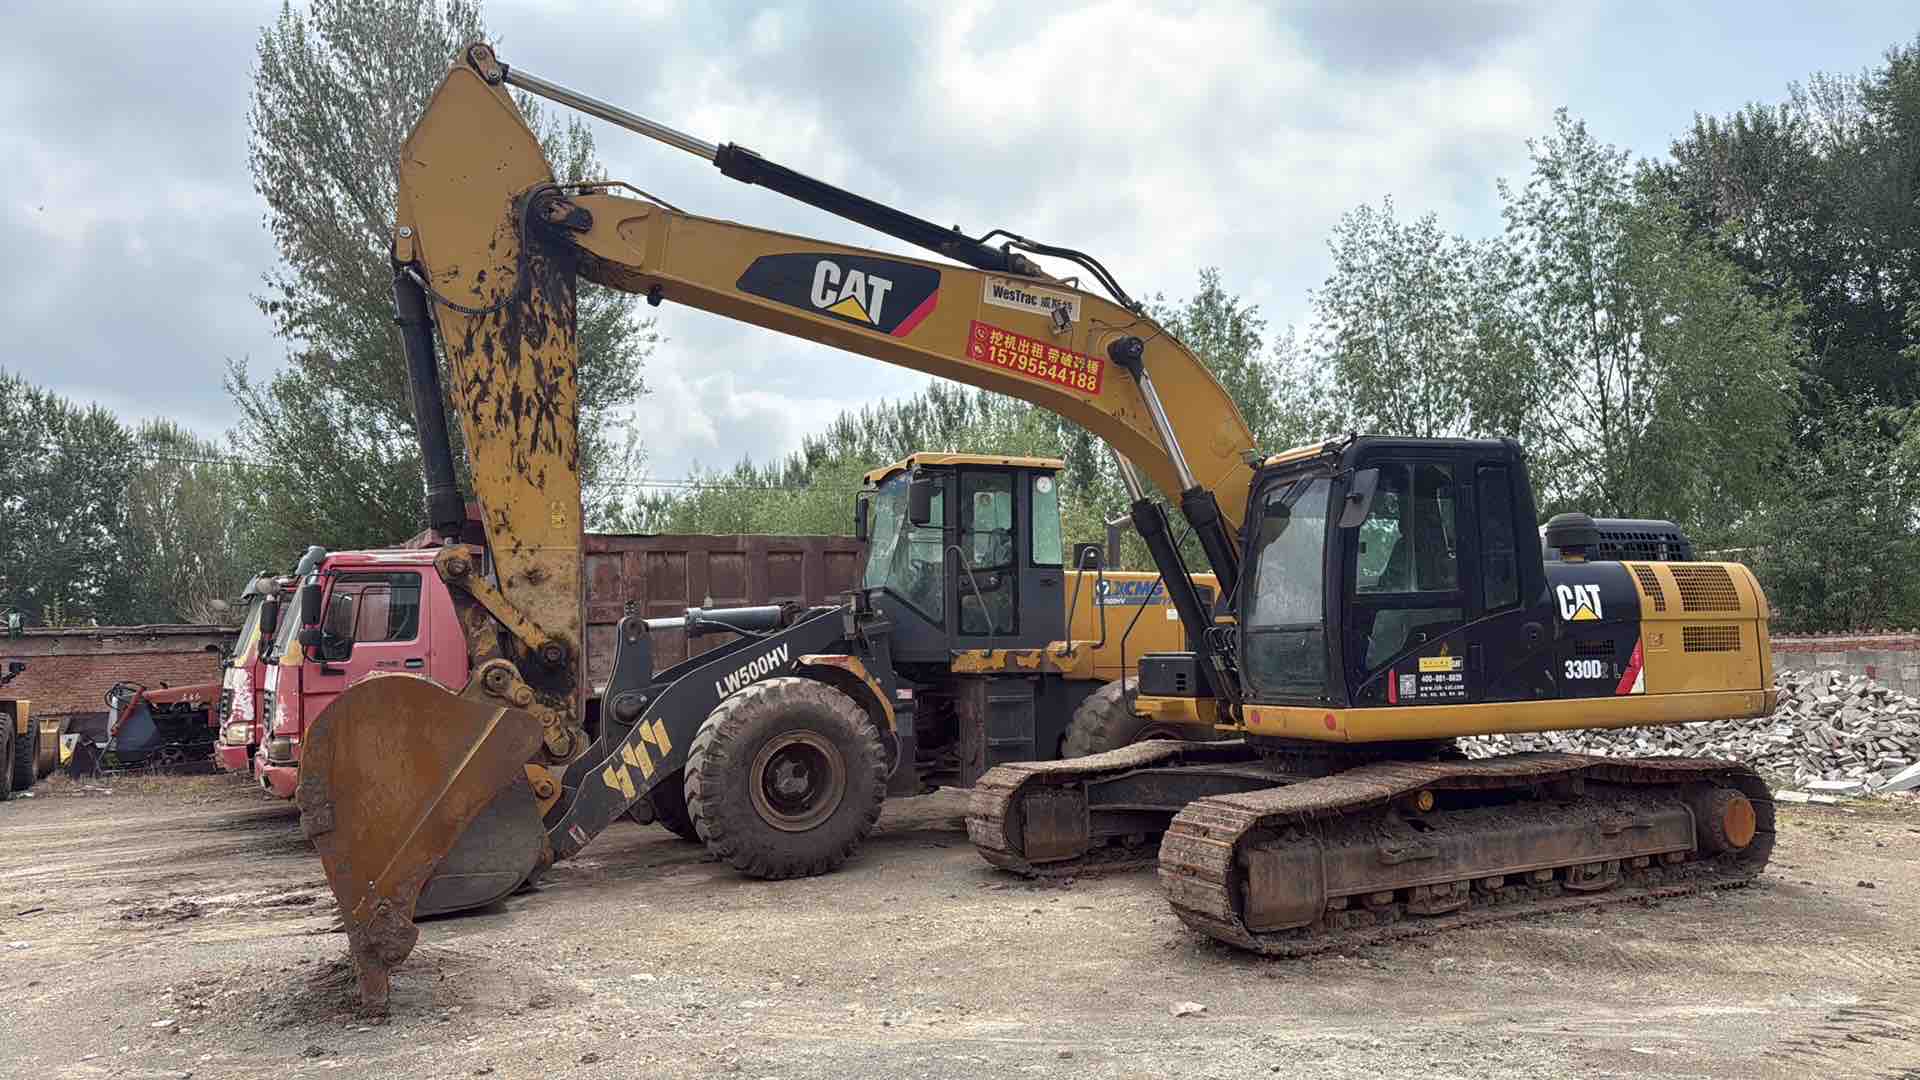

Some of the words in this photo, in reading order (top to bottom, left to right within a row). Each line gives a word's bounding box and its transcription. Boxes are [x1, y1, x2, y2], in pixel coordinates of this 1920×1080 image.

[810, 260, 893, 326] CAT
[993, 285, 1038, 306] WesTrac
[990, 329, 1044, 359] 挖机出租
[988, 345, 1097, 391] 15795544188
[1556, 584, 1603, 621] CAT
[715, 643, 789, 699] LW500HV
